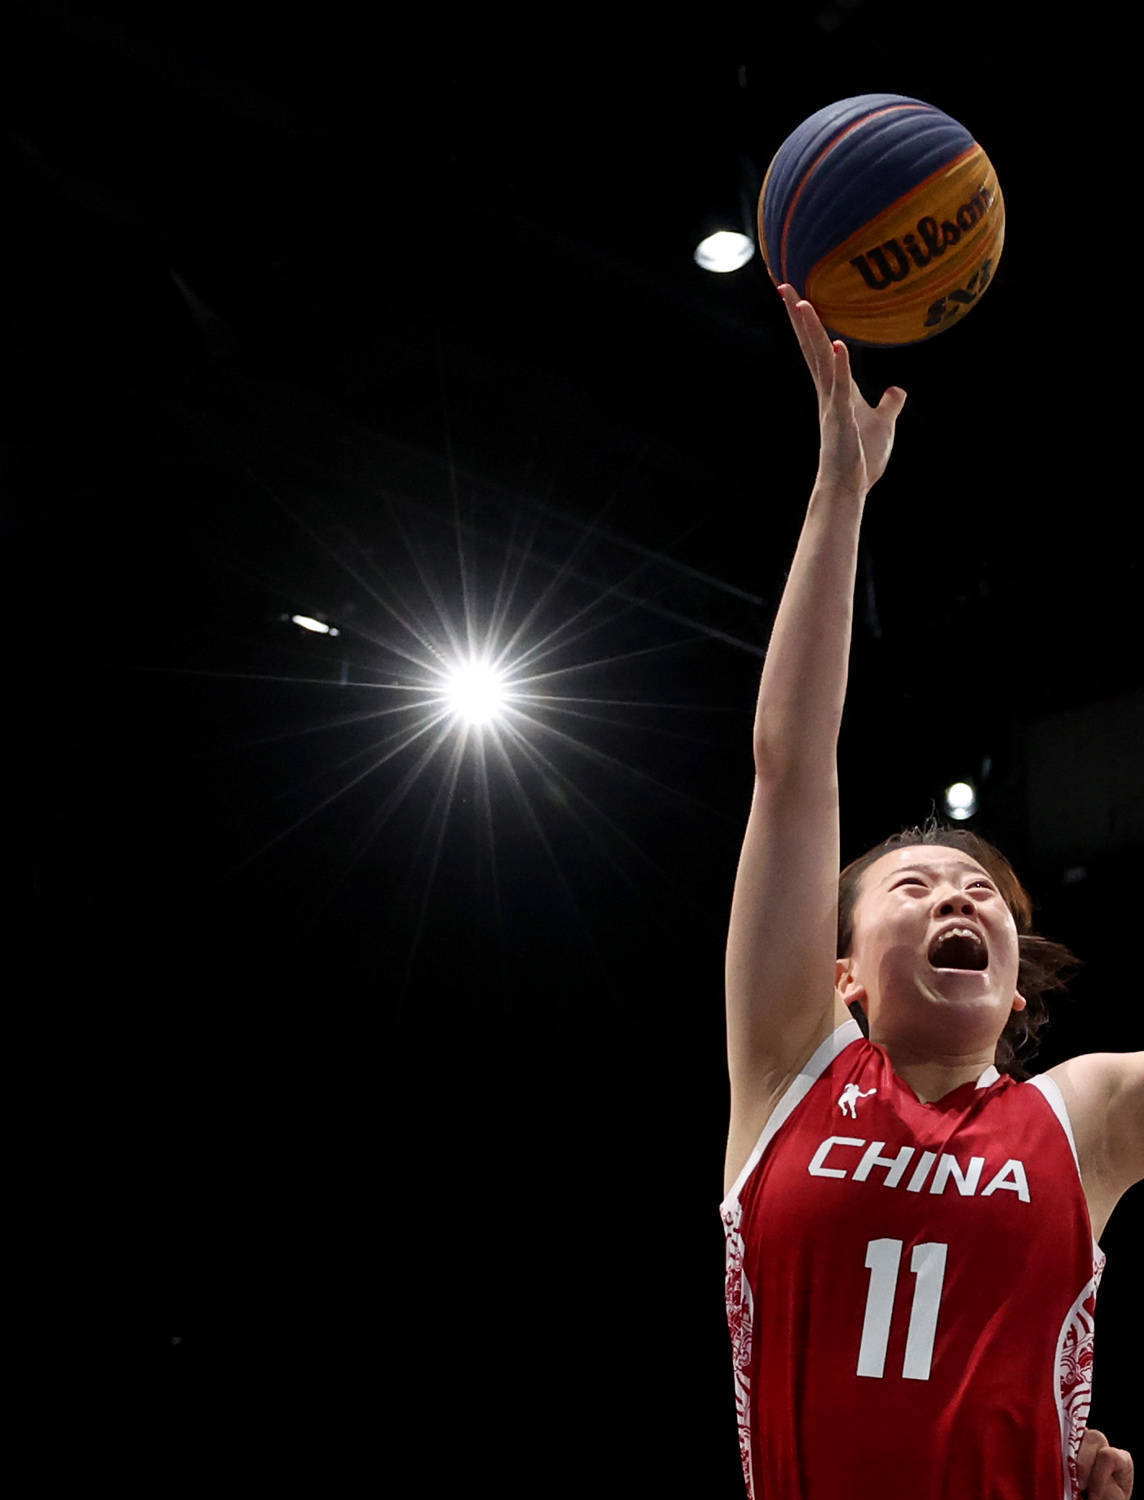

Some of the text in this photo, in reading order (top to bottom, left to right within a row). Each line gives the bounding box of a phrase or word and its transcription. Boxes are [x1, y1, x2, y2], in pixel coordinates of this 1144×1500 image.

[849, 187, 995, 290] Wilson
[807, 1135, 1031, 1203] CHINA
[856, 1237, 948, 1381] 11
